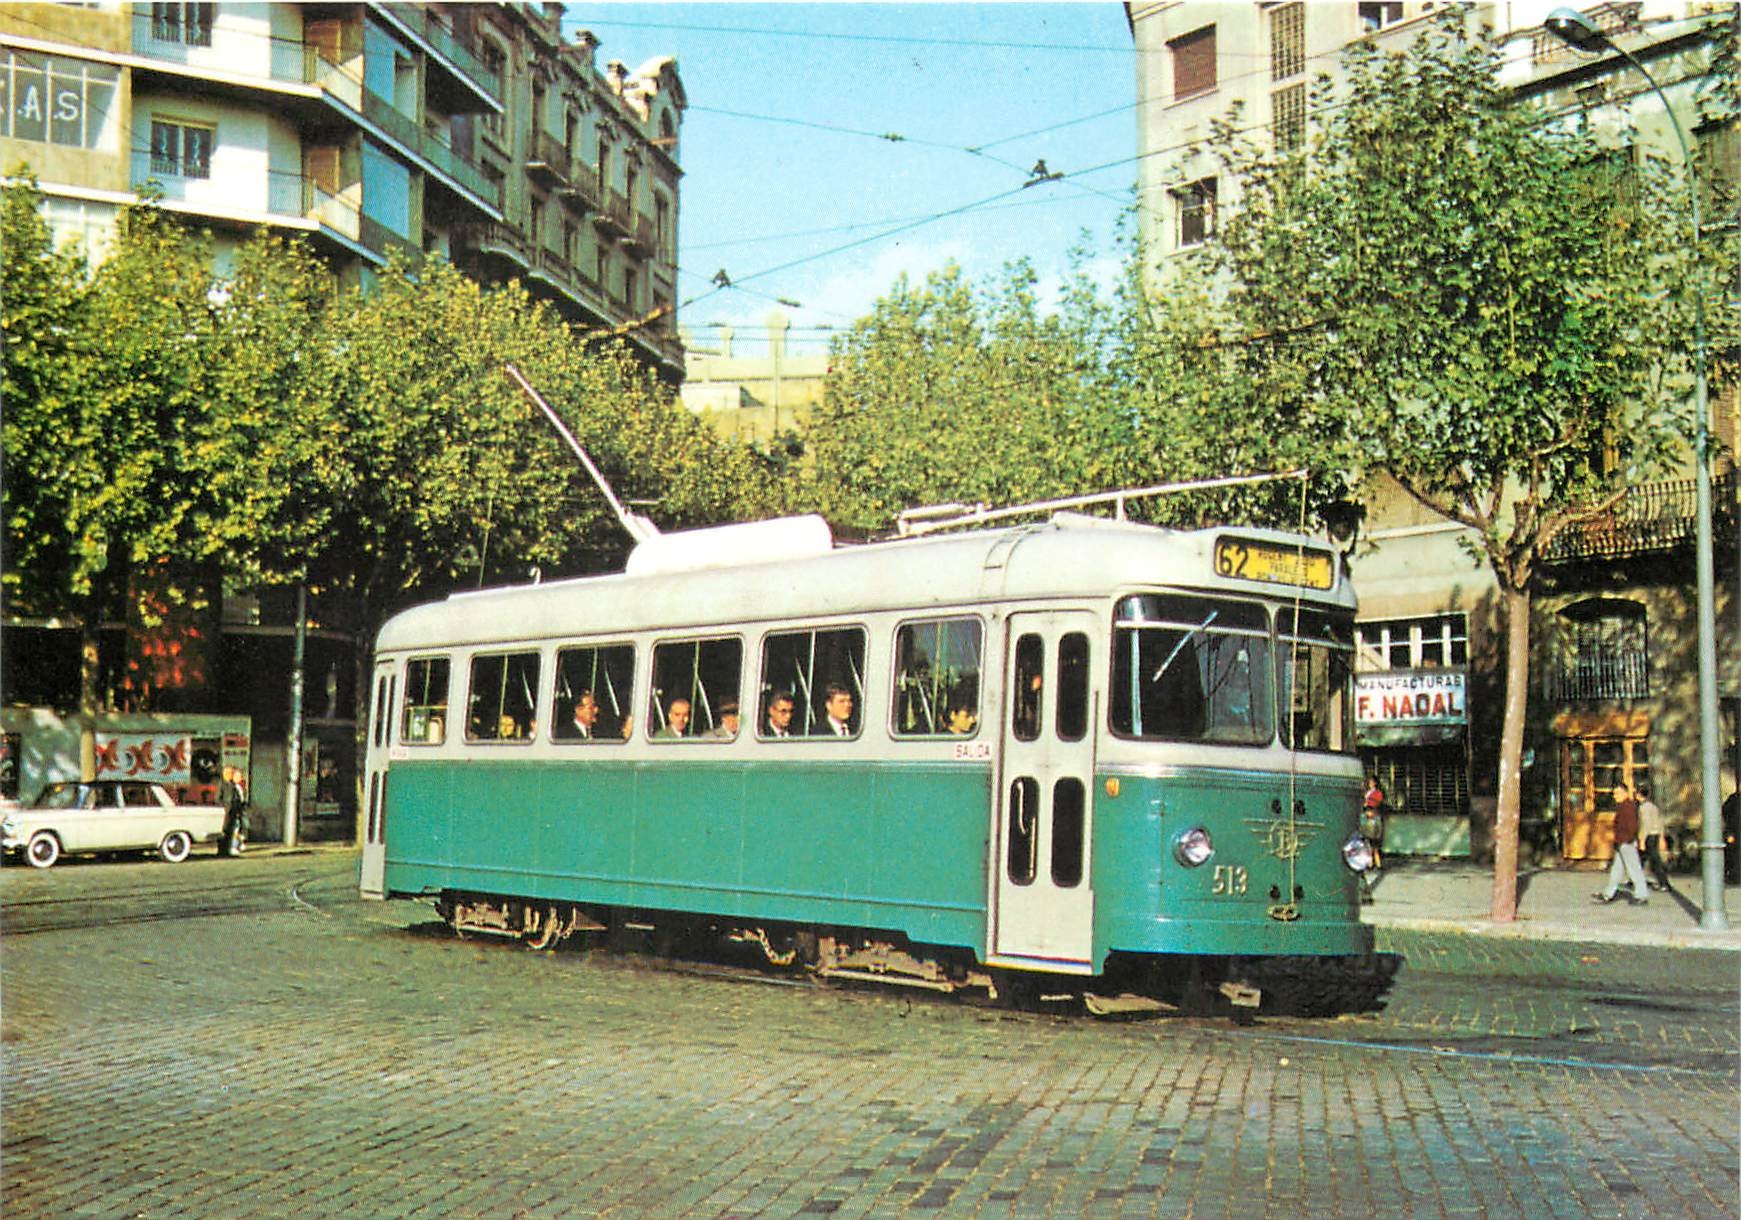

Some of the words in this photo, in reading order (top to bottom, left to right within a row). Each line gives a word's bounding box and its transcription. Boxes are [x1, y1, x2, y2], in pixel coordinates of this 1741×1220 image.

[1219, 543, 1247, 577] 62
[1353, 675, 1463, 690] MANUFACTURAS
[1358, 695, 1375, 719] F.
[1382, 692, 1463, 719] NADAL
[956, 744, 990, 758] SALDA
[1212, 865, 1248, 896] 513
